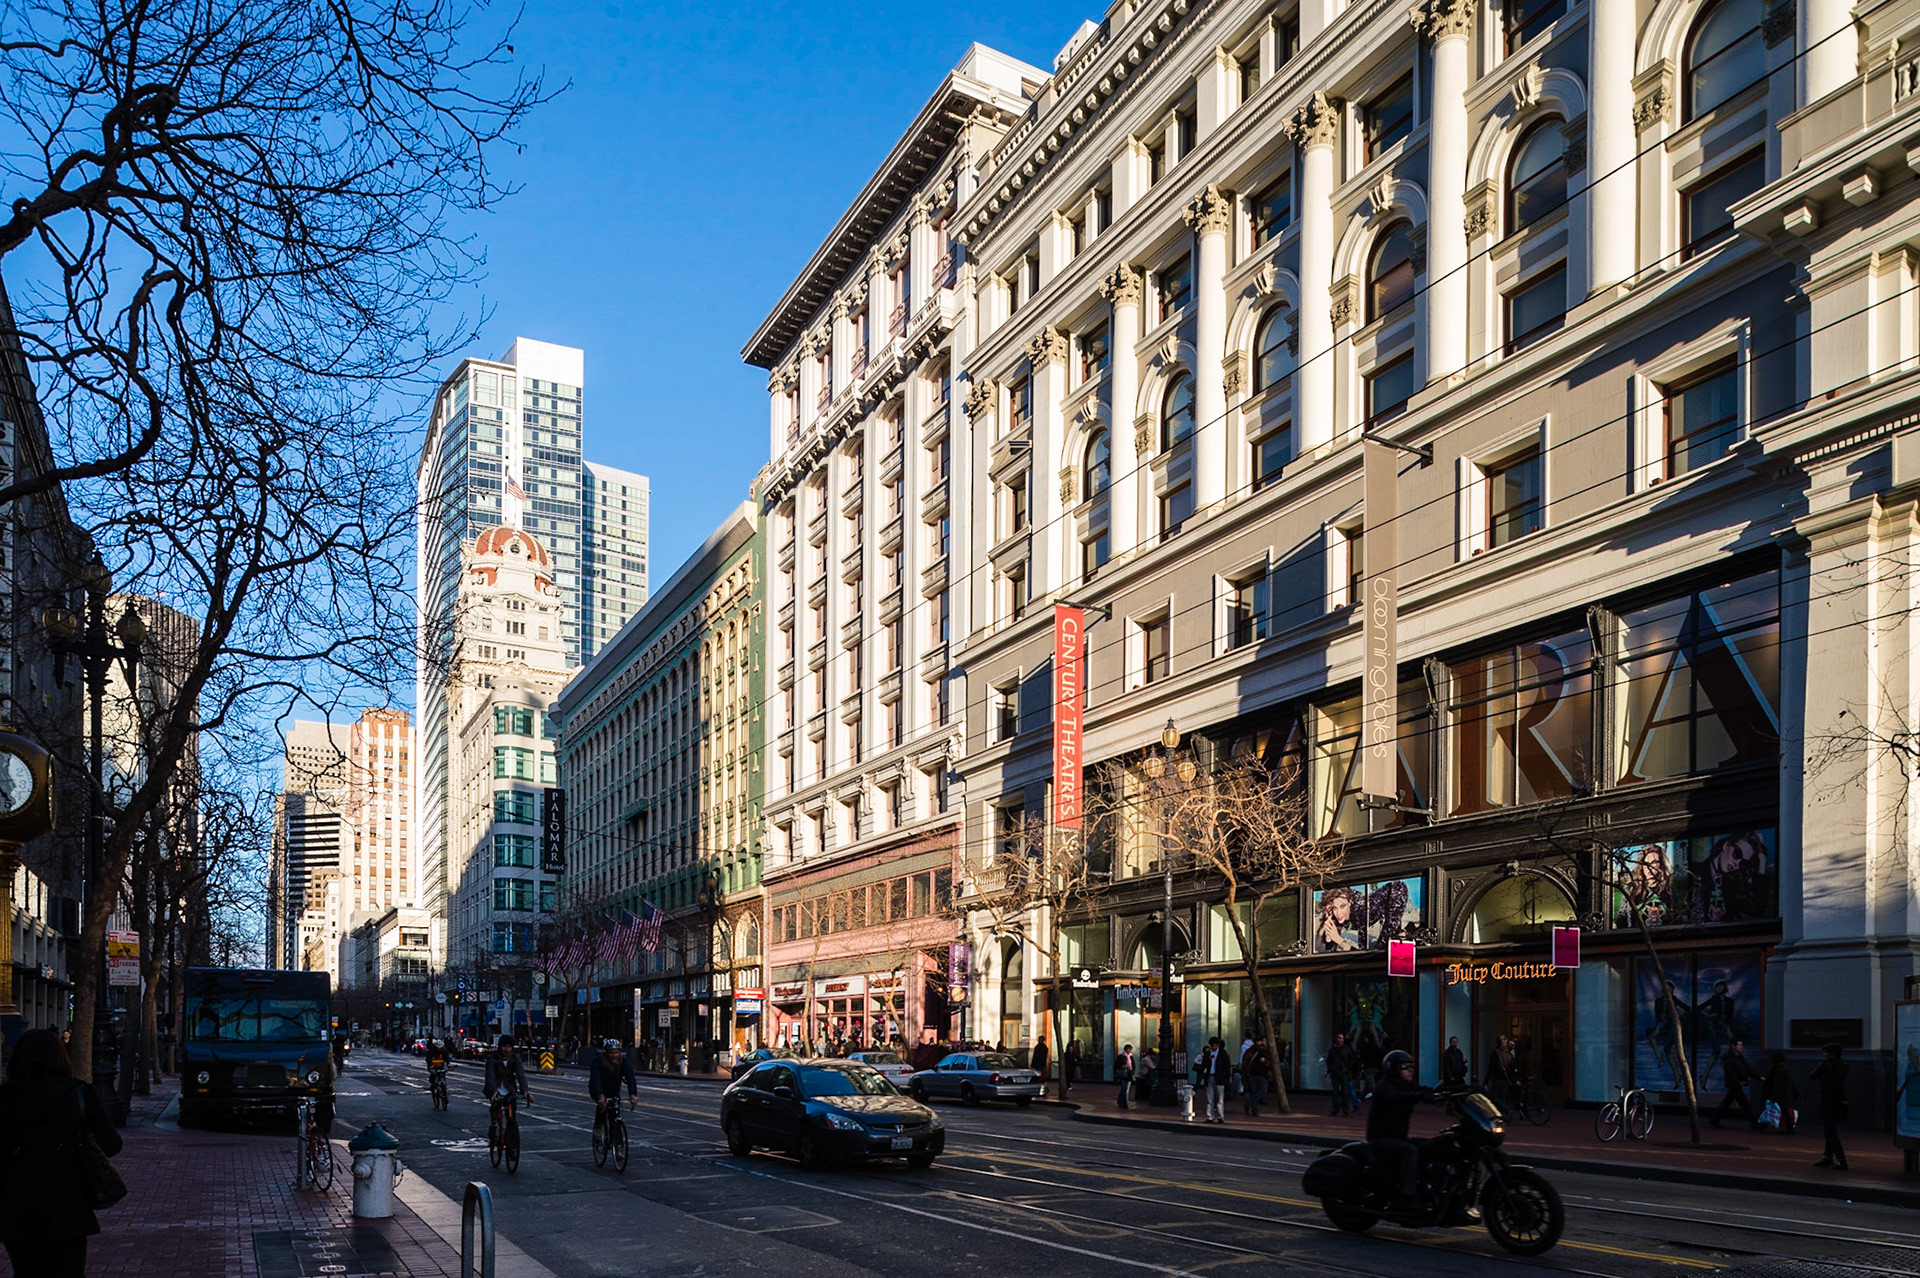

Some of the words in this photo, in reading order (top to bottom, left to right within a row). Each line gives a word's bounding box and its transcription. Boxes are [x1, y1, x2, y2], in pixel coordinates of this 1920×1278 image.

[1061, 617, 1078, 712] CENTURY
[1060, 716, 1077, 817] THEATRES
[549, 791, 561, 862] PALOMAR
[545, 863, 565, 871] Hotel
[1072, 978, 1100, 988] Timberland
[1448, 962, 1489, 985] Juicy
[1490, 961, 1557, 981] Couture
